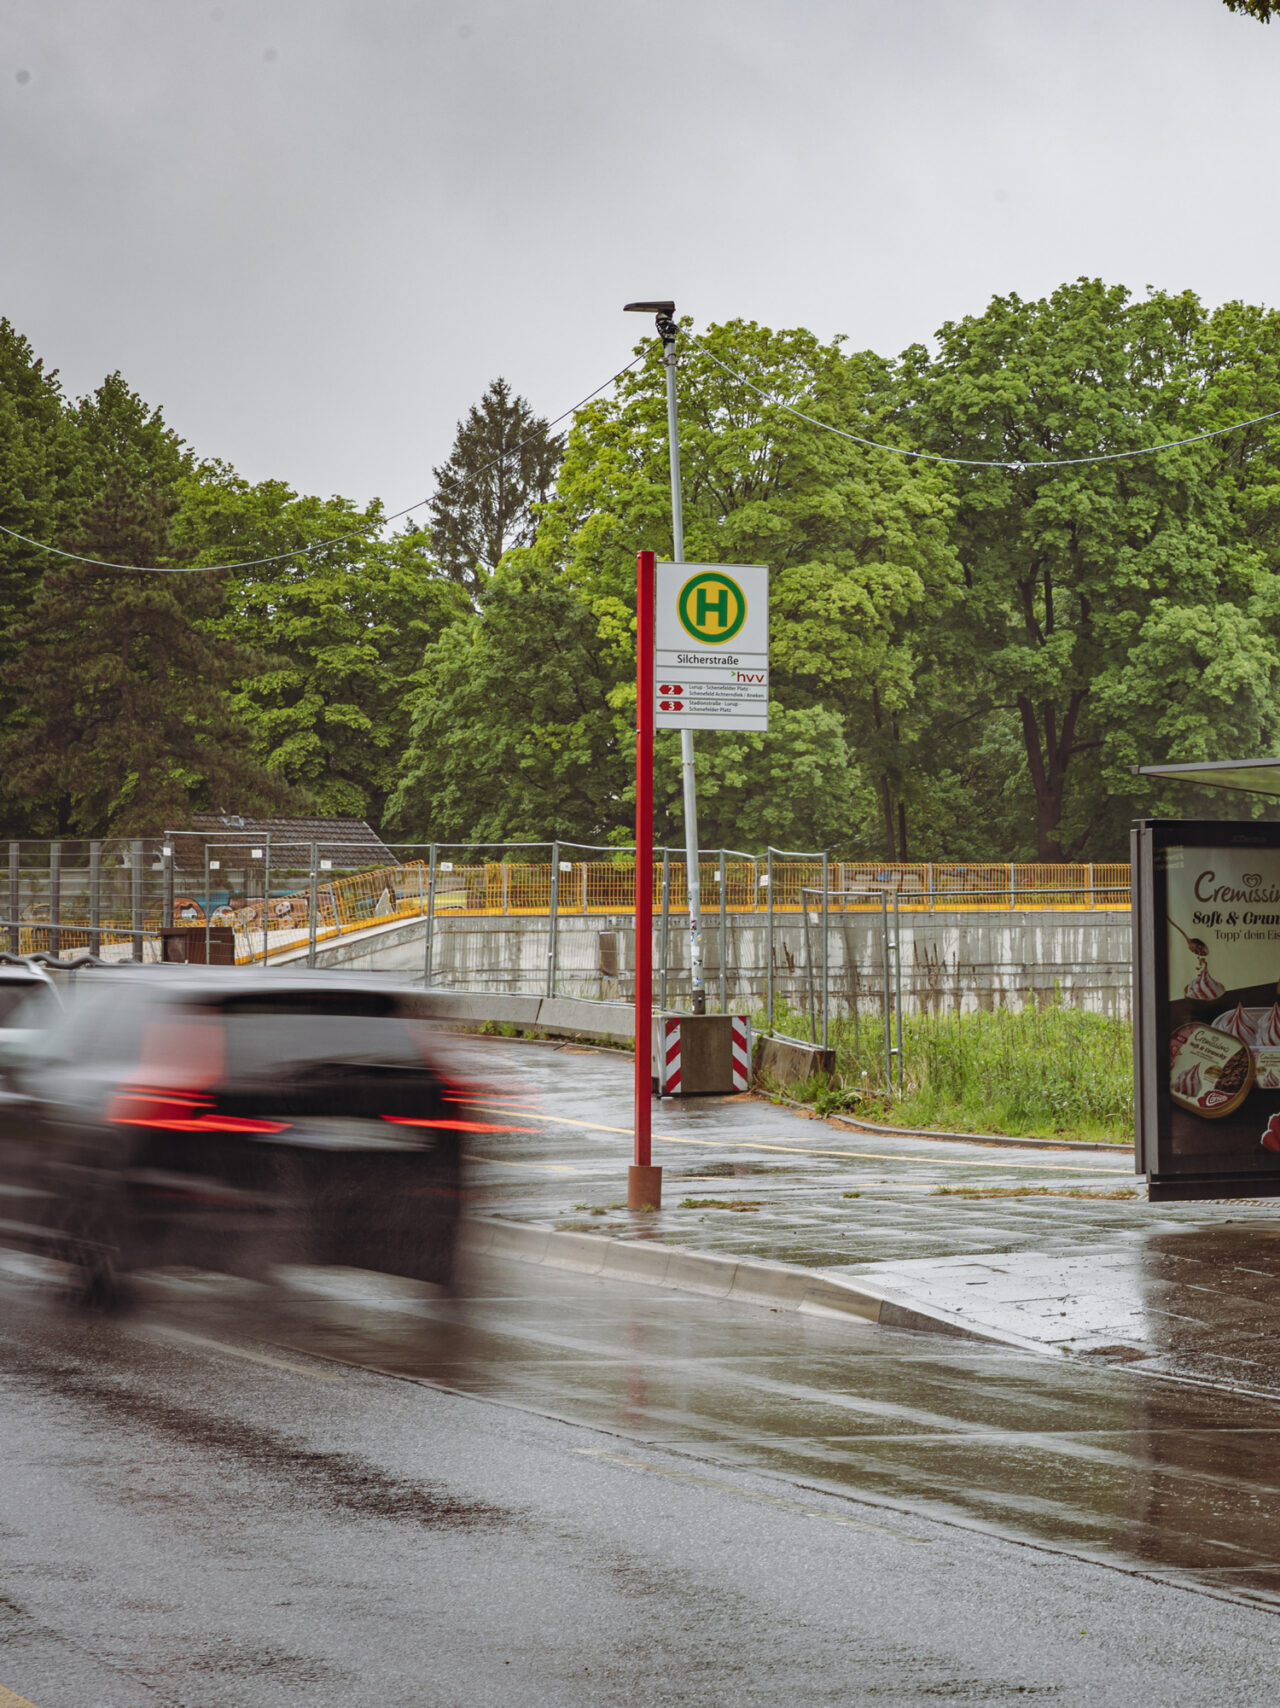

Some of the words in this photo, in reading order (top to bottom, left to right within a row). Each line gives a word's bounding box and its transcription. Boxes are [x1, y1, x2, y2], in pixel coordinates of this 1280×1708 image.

[696, 588, 728, 627] H
[677, 654, 739, 665] Silcherstraße
[737, 671, 764, 683] hvv
[668, 685, 674, 694] 2
[668, 701, 675, 711] 3
[1192, 911, 1222, 928] Soft
[1226, 912, 1239, 926] &
[1244, 929, 1265, 940] dein
